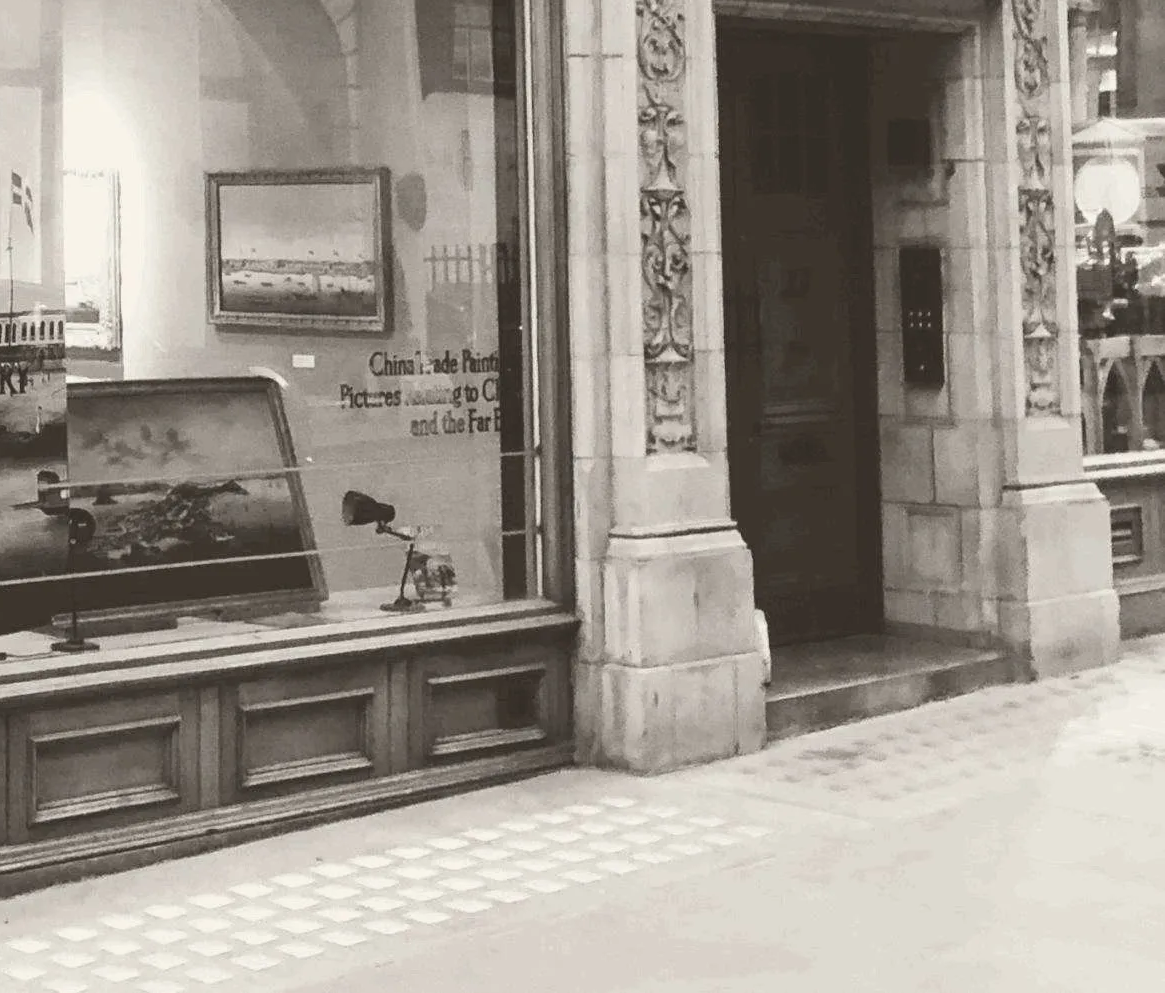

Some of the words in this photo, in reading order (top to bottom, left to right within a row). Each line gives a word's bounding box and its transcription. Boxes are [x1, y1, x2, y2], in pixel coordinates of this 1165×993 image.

[368, 351, 414, 377] China
[465, 384, 479, 403] to
[410, 411, 438, 437] and
[442, 410, 465, 434] the
[468, 409, 491, 434] Far
